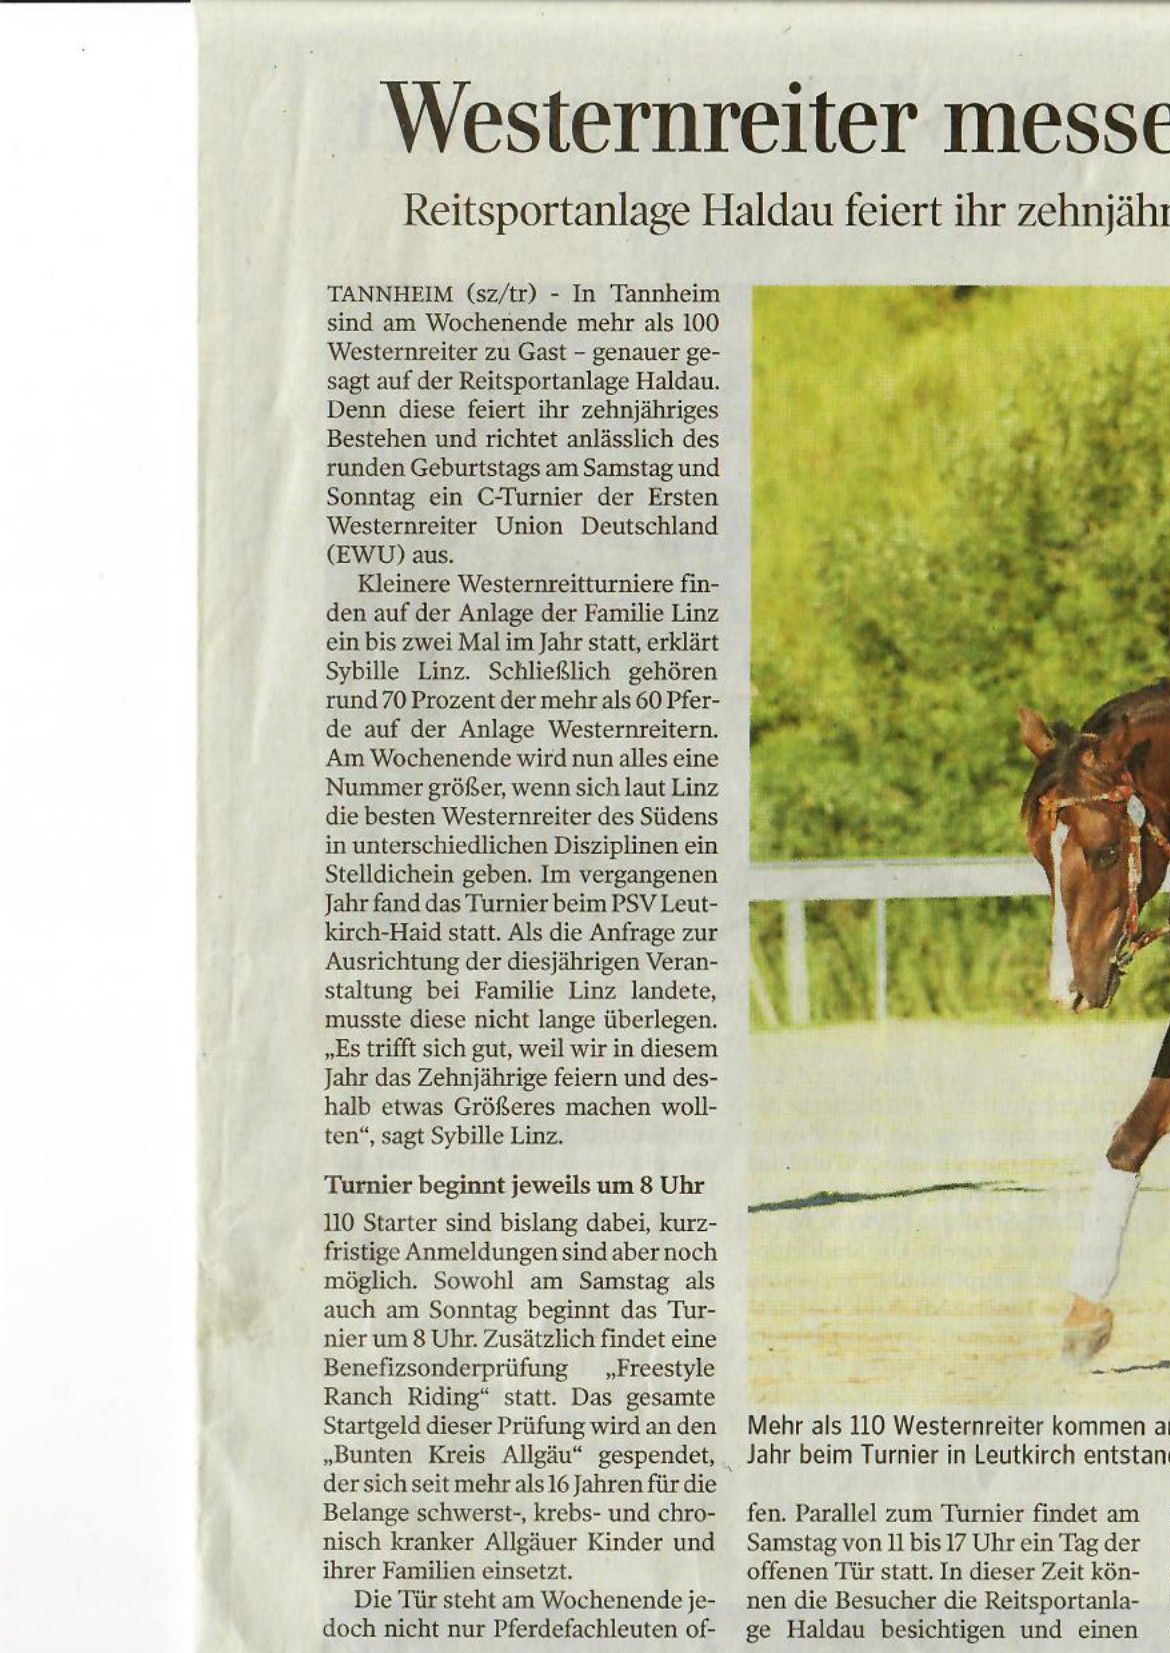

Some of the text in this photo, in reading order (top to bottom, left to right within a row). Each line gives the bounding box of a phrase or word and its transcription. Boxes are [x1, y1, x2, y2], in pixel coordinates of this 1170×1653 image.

[379, 80, 919, 155] Westernreiter
[403, 191, 691, 236] Reitsportanlage
[701, 191, 834, 227] Haldau
[844, 191, 943, 228] feiert
[954, 191, 1007, 227] ihr
[326, 284, 454, 304] TANNHEIM
[466, 281, 537, 305] (sz/tr)
[572, 283, 596, 303] In
[609, 282, 721, 304] Tannheim
[327, 311, 720, 333] sind am Wochenende mehr als 100
[326, 340, 479, 362] Westernreiter
[484, 346, 512, 362] zu
[518, 341, 567, 362] Gast
[592, 346, 681, 367] genauer
[686, 346, 721, 367] ge-
[327, 369, 720, 396] sagt auf der Reitsportanlage Haldau.
[357, 572, 720, 594] Kleinere Westernreitturniere fin-
[323, 1173, 706, 1200] Turnier beginnt jeweils um 8 Uhr
[323, 1211, 717, 1238] 110 Starter sind bislang dabei, kurz-
[323, 1356, 716, 1383] Benefizsonderprüfung „Freestyle
[747, 1413, 804, 1436] Mehr
[811, 1413, 843, 1436] als
[850, 1414, 886, 1436] 110
[893, 1414, 1045, 1436] Westernreiter
[1052, 1414, 1146, 1437] kommen
[746, 1442, 792, 1465] Jahr
[799, 1442, 853, 1465] beim
[860, 1443, 940, 1465] Turnier
[947, 1443, 966, 1465] in
[975, 1443, 1076, 1466] Leutkirch
[747, 1501, 1141, 1523] fen. Parallel zum Turnier findet am
[747, 1531, 1141, 1558] Samstag von 11 bis 17 Uhr ein Tag der
